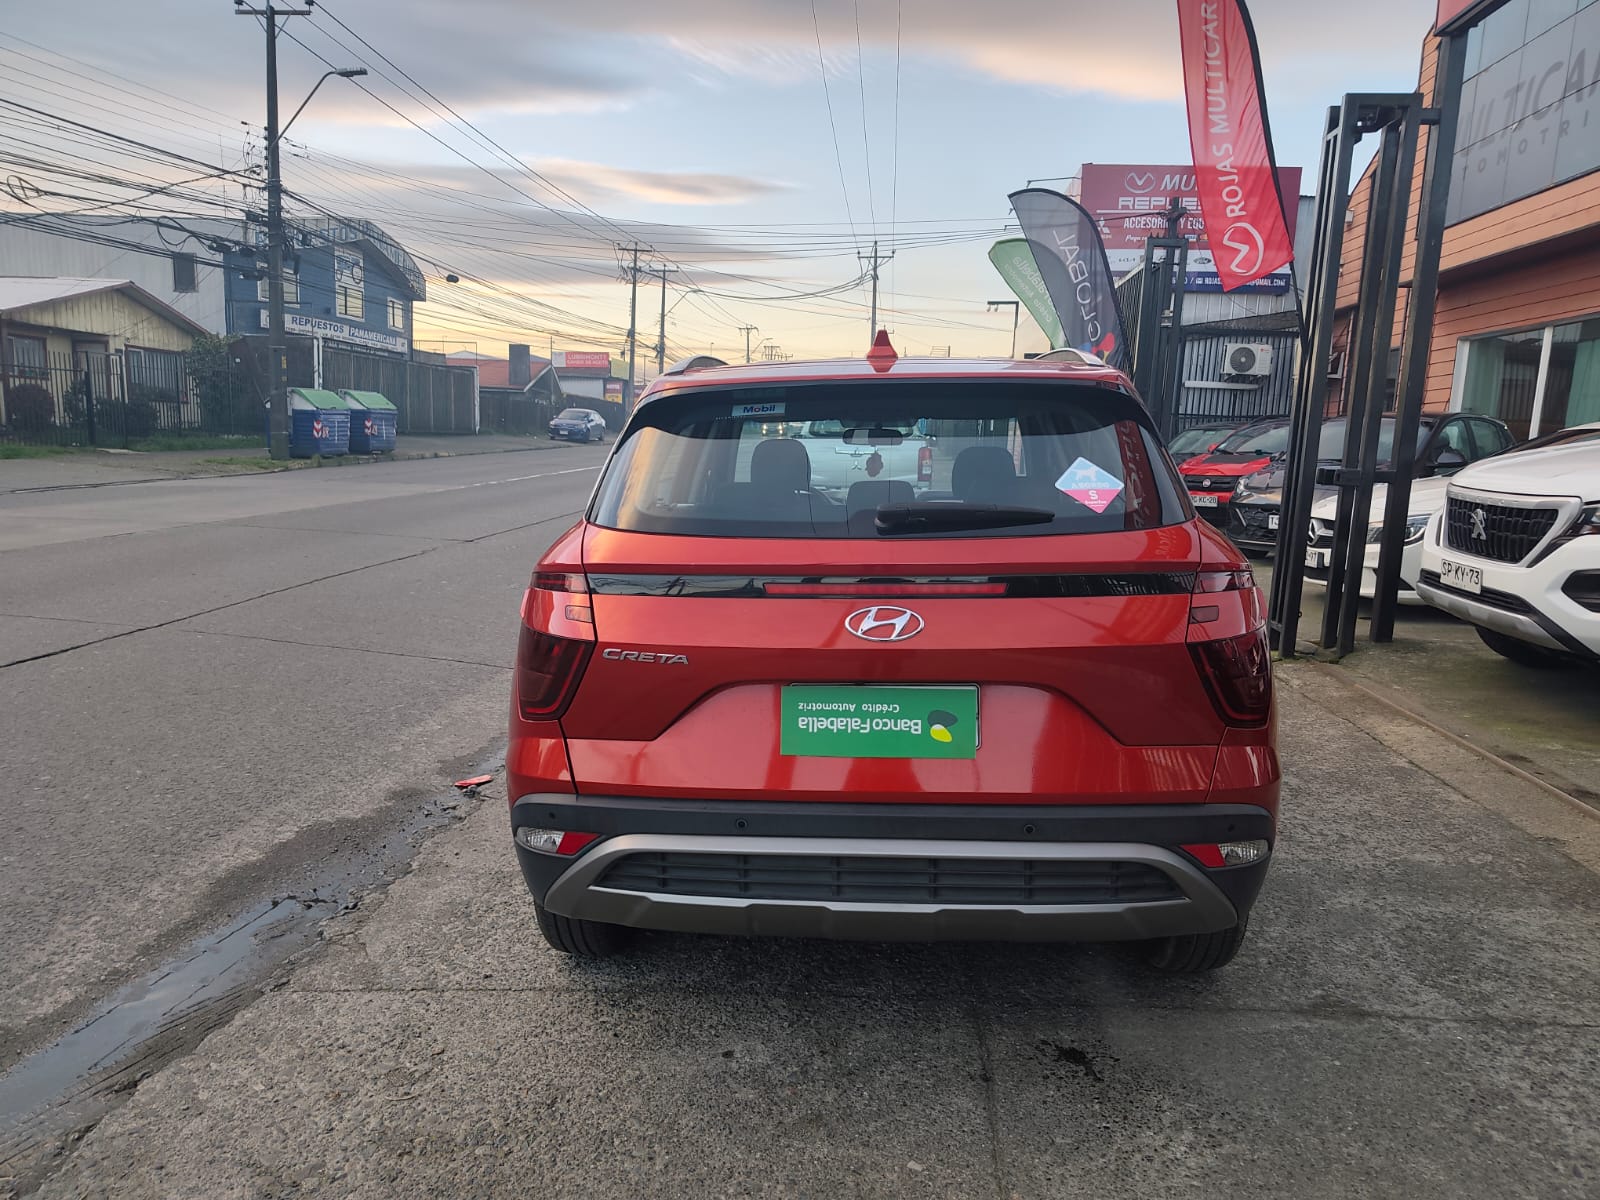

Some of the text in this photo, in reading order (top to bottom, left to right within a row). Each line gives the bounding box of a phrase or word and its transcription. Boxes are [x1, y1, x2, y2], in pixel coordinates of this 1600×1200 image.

[1201, 1, 1247, 218] ROJAS MULTICAR
[1460, 47, 1600, 159] ULTICA
[1461, 109, 1590, 183] TOMOTRI
[1160, 174, 1198, 191] MU
[1118, 196, 1203, 210] REPUE
[1124, 218, 1169, 229] ACCESORI
[291, 315, 345, 334] REPUESTOS
[743, 405, 776, 414] Mobil
[1088, 490, 1099, 500] S
[602, 648, 689, 666] CRETA
[798, 702, 900, 713] Crédito Automotriz
